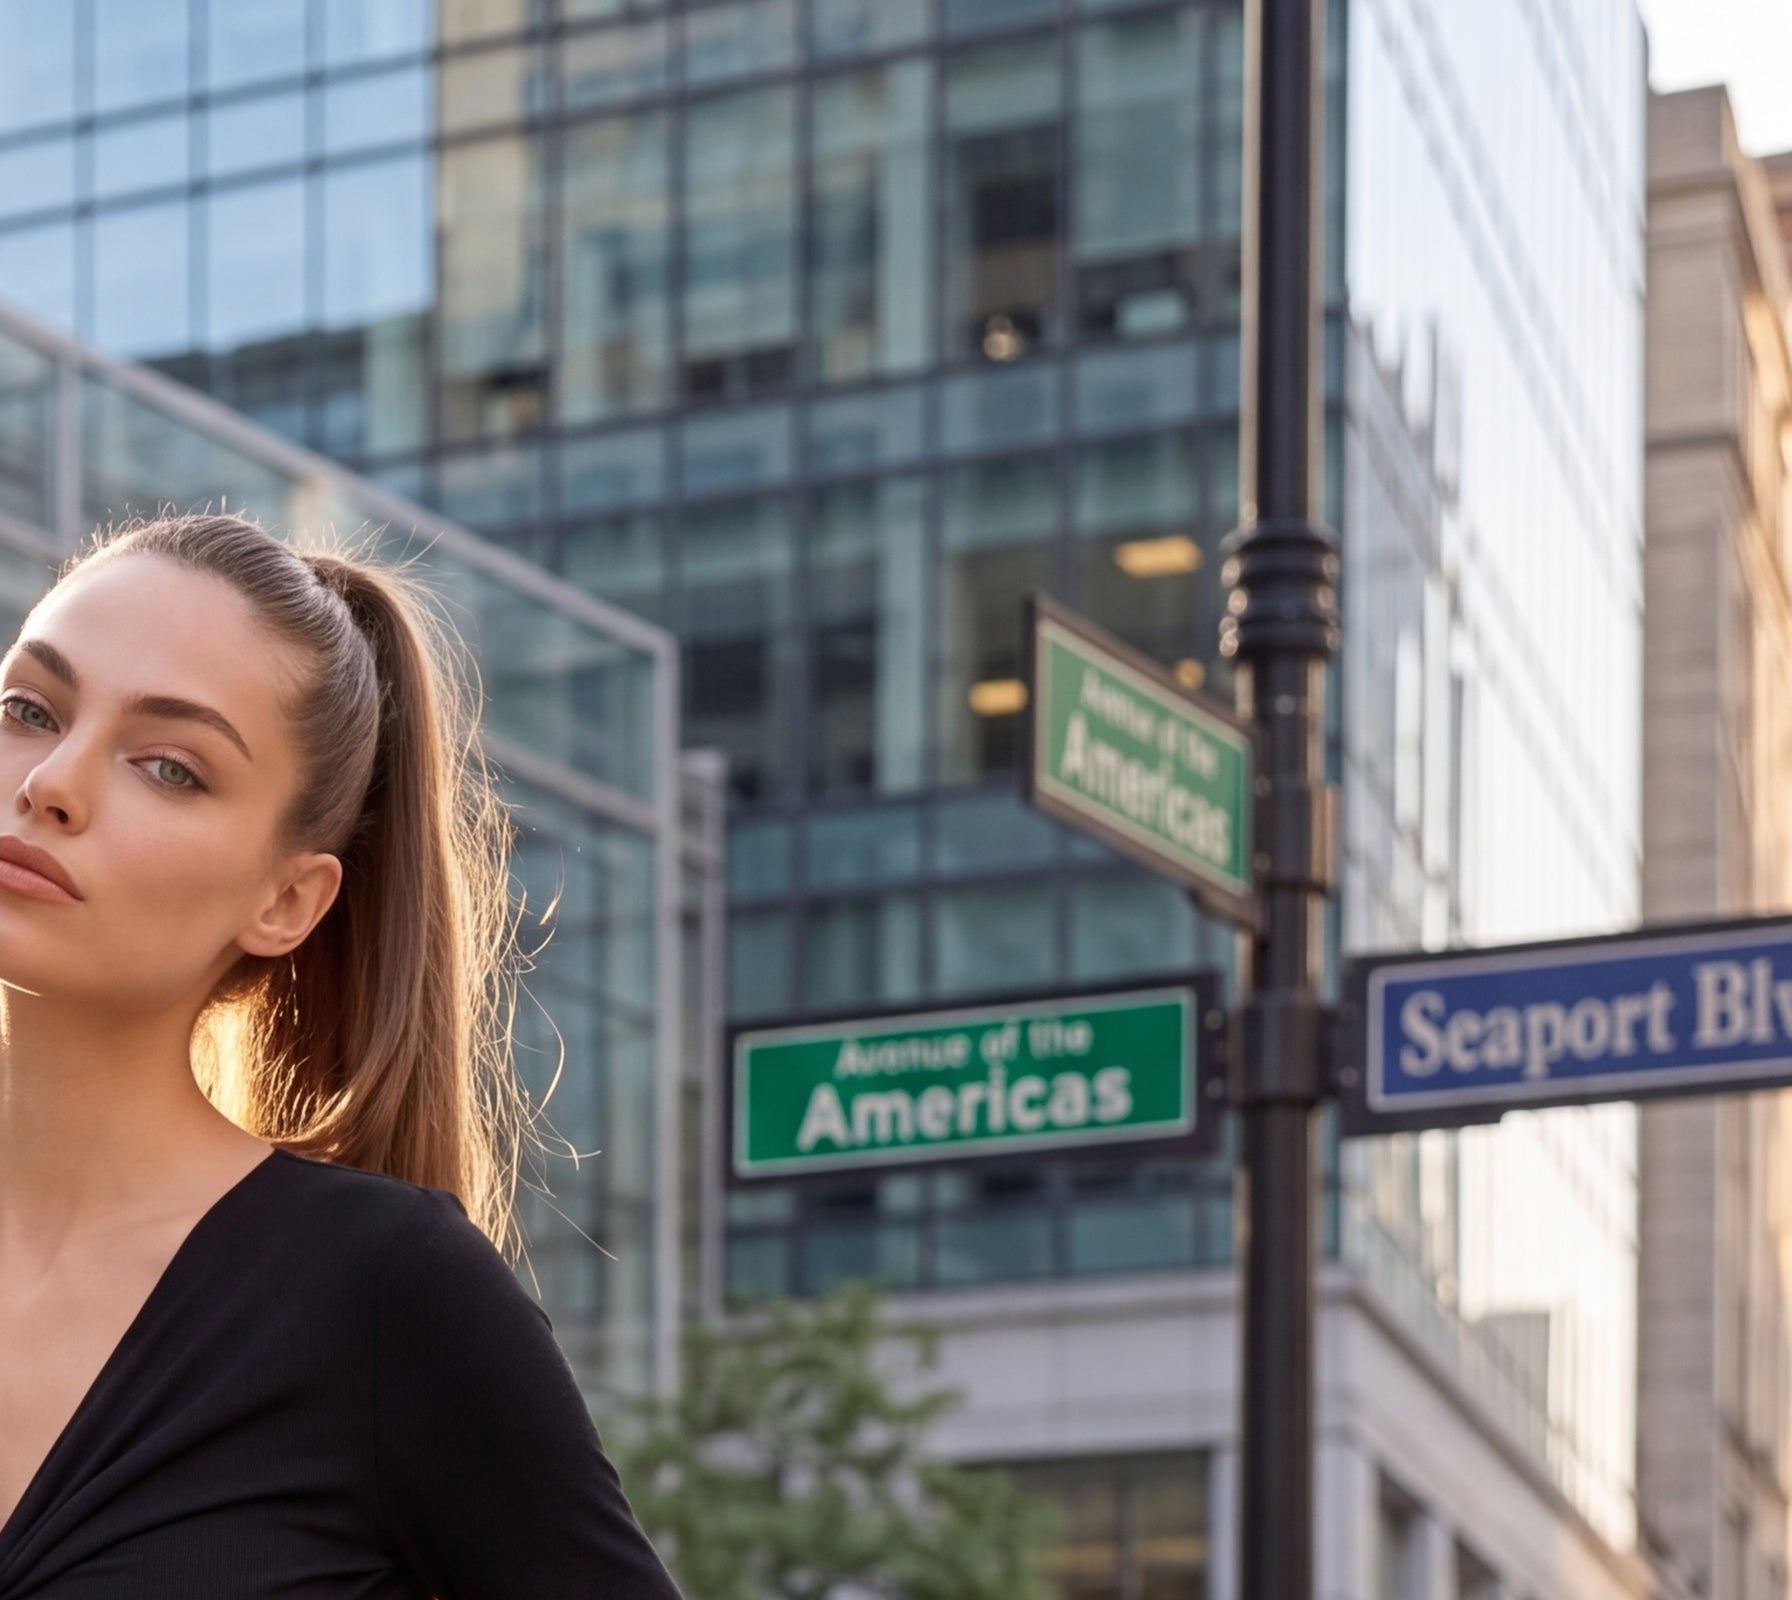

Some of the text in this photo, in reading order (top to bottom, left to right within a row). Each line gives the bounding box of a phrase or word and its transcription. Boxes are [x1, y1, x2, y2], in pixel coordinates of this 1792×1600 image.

[1060, 709, 1231, 867] Americas
[834, 1018, 1093, 1080] Avenue of the
[1399, 978, 1676, 1080] Seaport
[795, 1064, 1134, 1153] Americas
